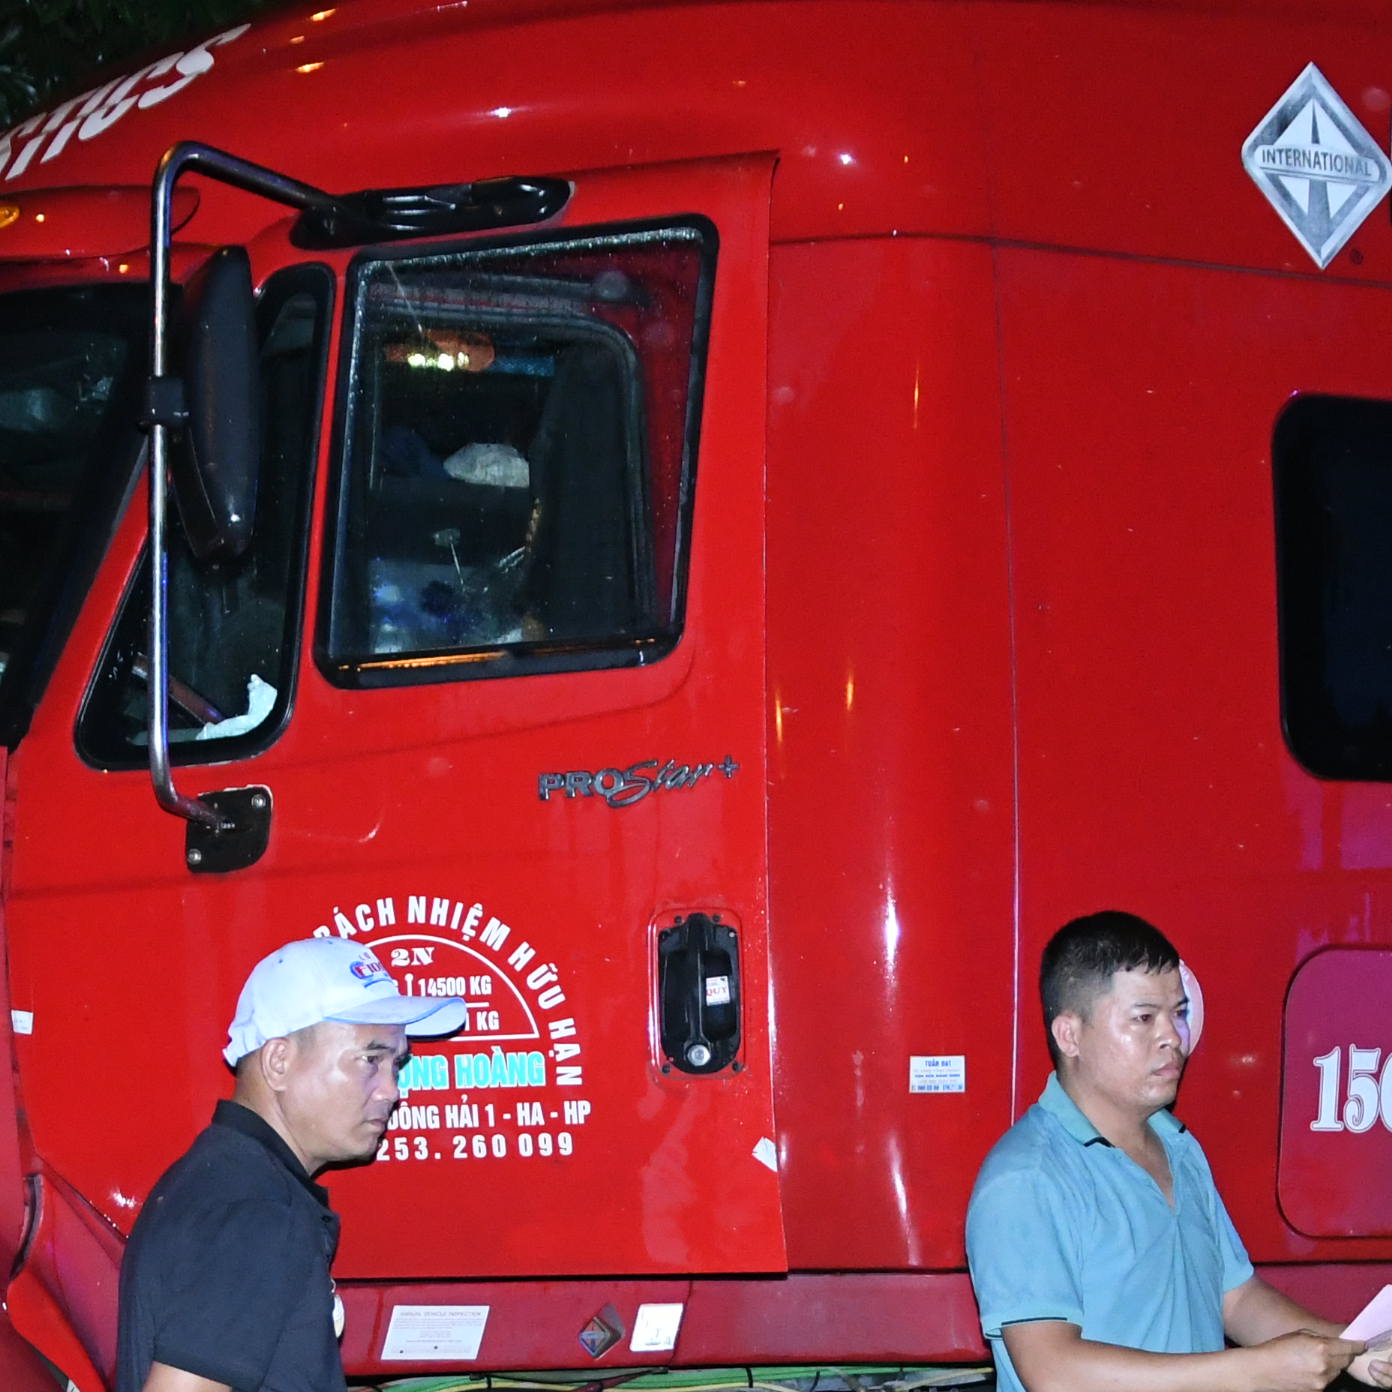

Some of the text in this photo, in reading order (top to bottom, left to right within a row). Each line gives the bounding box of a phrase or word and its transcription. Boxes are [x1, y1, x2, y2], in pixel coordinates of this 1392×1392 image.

[1261, 148, 1373, 178] INTERNATIONAL
[391, 947, 436, 967] 2N
[408, 895, 511, 951] NHIỆM
[508, 941, 566, 1010] HỮU
[548, 1017, 583, 1086] HẠN
[418, 976, 466, 997] 14500
[469, 974, 493, 995] KG
[476, 1011, 500, 1031] KG
[454, 1046, 546, 1089] HOÀNG
[445, 1094, 479, 1128] HẢI
[484, 1104, 495, 1126] 1
[516, 1102, 545, 1126] HA
[563, 1100, 592, 1125] HP
[452, 1135, 506, 1159] 260
[518, 1132, 573, 1157] 099
